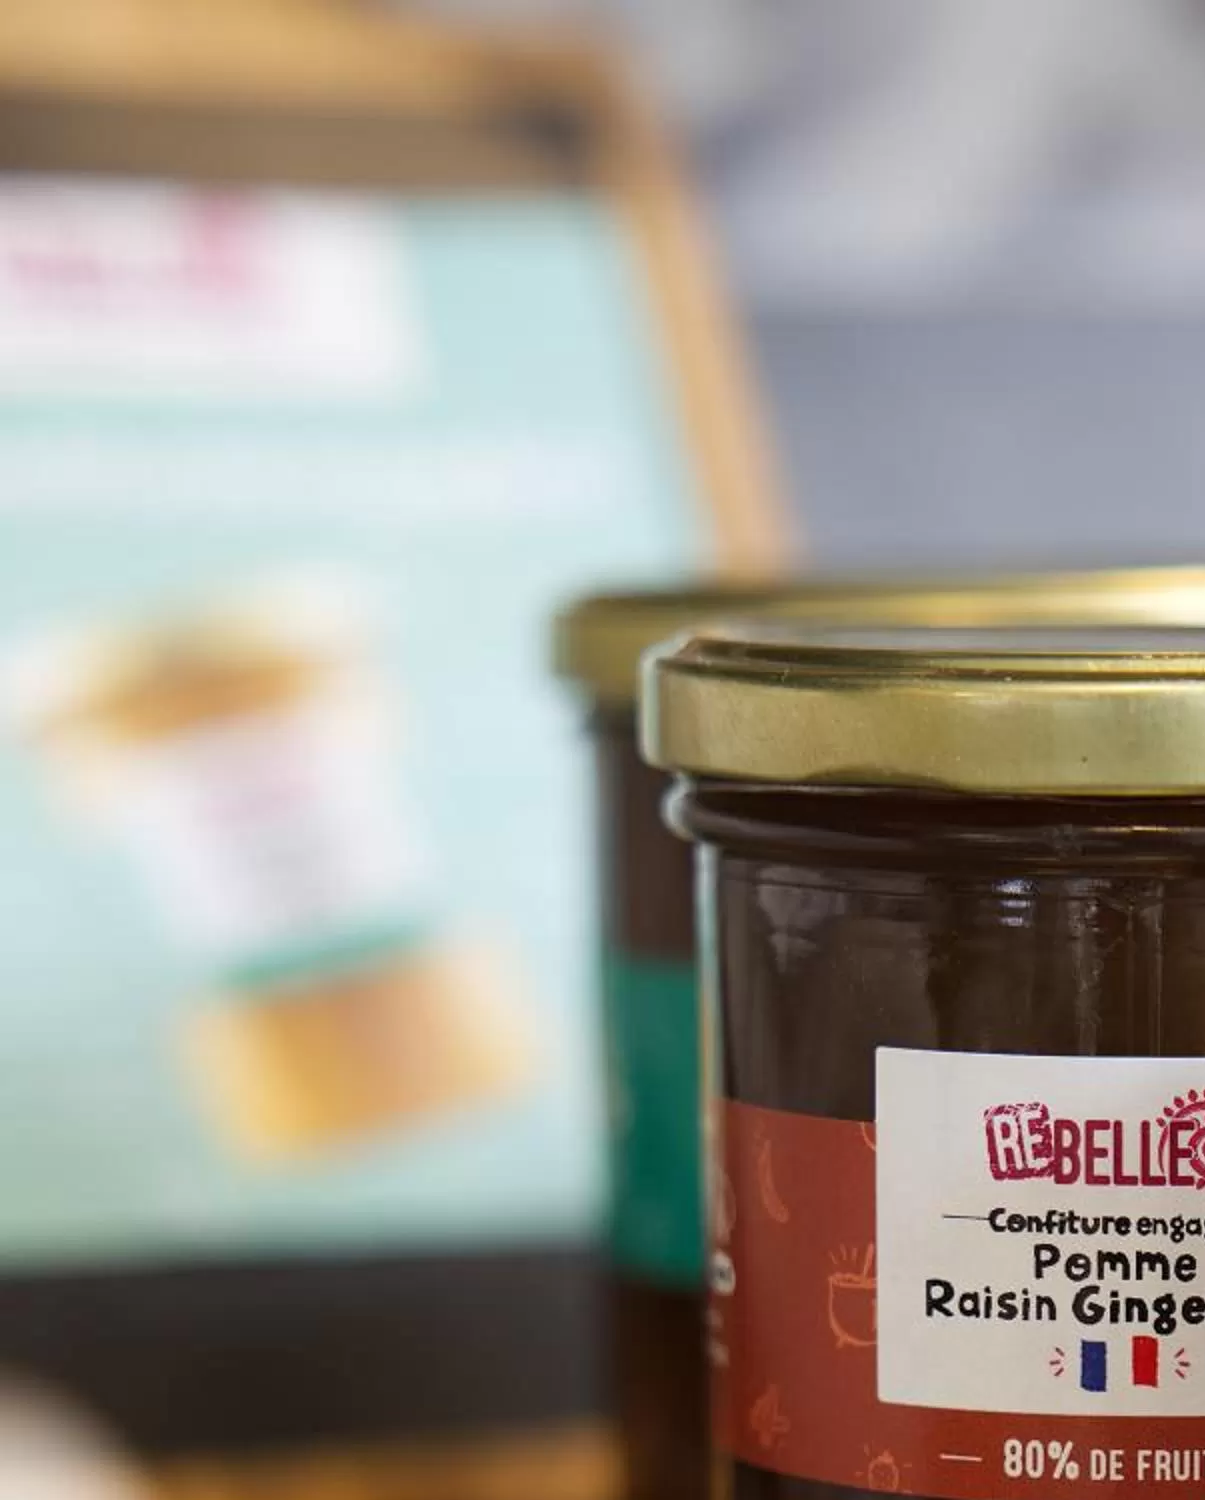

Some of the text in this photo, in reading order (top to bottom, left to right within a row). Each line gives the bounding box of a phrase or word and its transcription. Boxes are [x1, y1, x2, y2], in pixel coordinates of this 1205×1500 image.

[984, 1101, 1196, 1187] REBELLE
[988, 1207, 1131, 1236] Confiture
[1033, 1243, 1198, 1283] Pomme
[924, 1278, 1058, 1321] Raisin
[1002, 1438, 1080, 1481] 80%
[1090, 1449, 1125, 1481] DE
